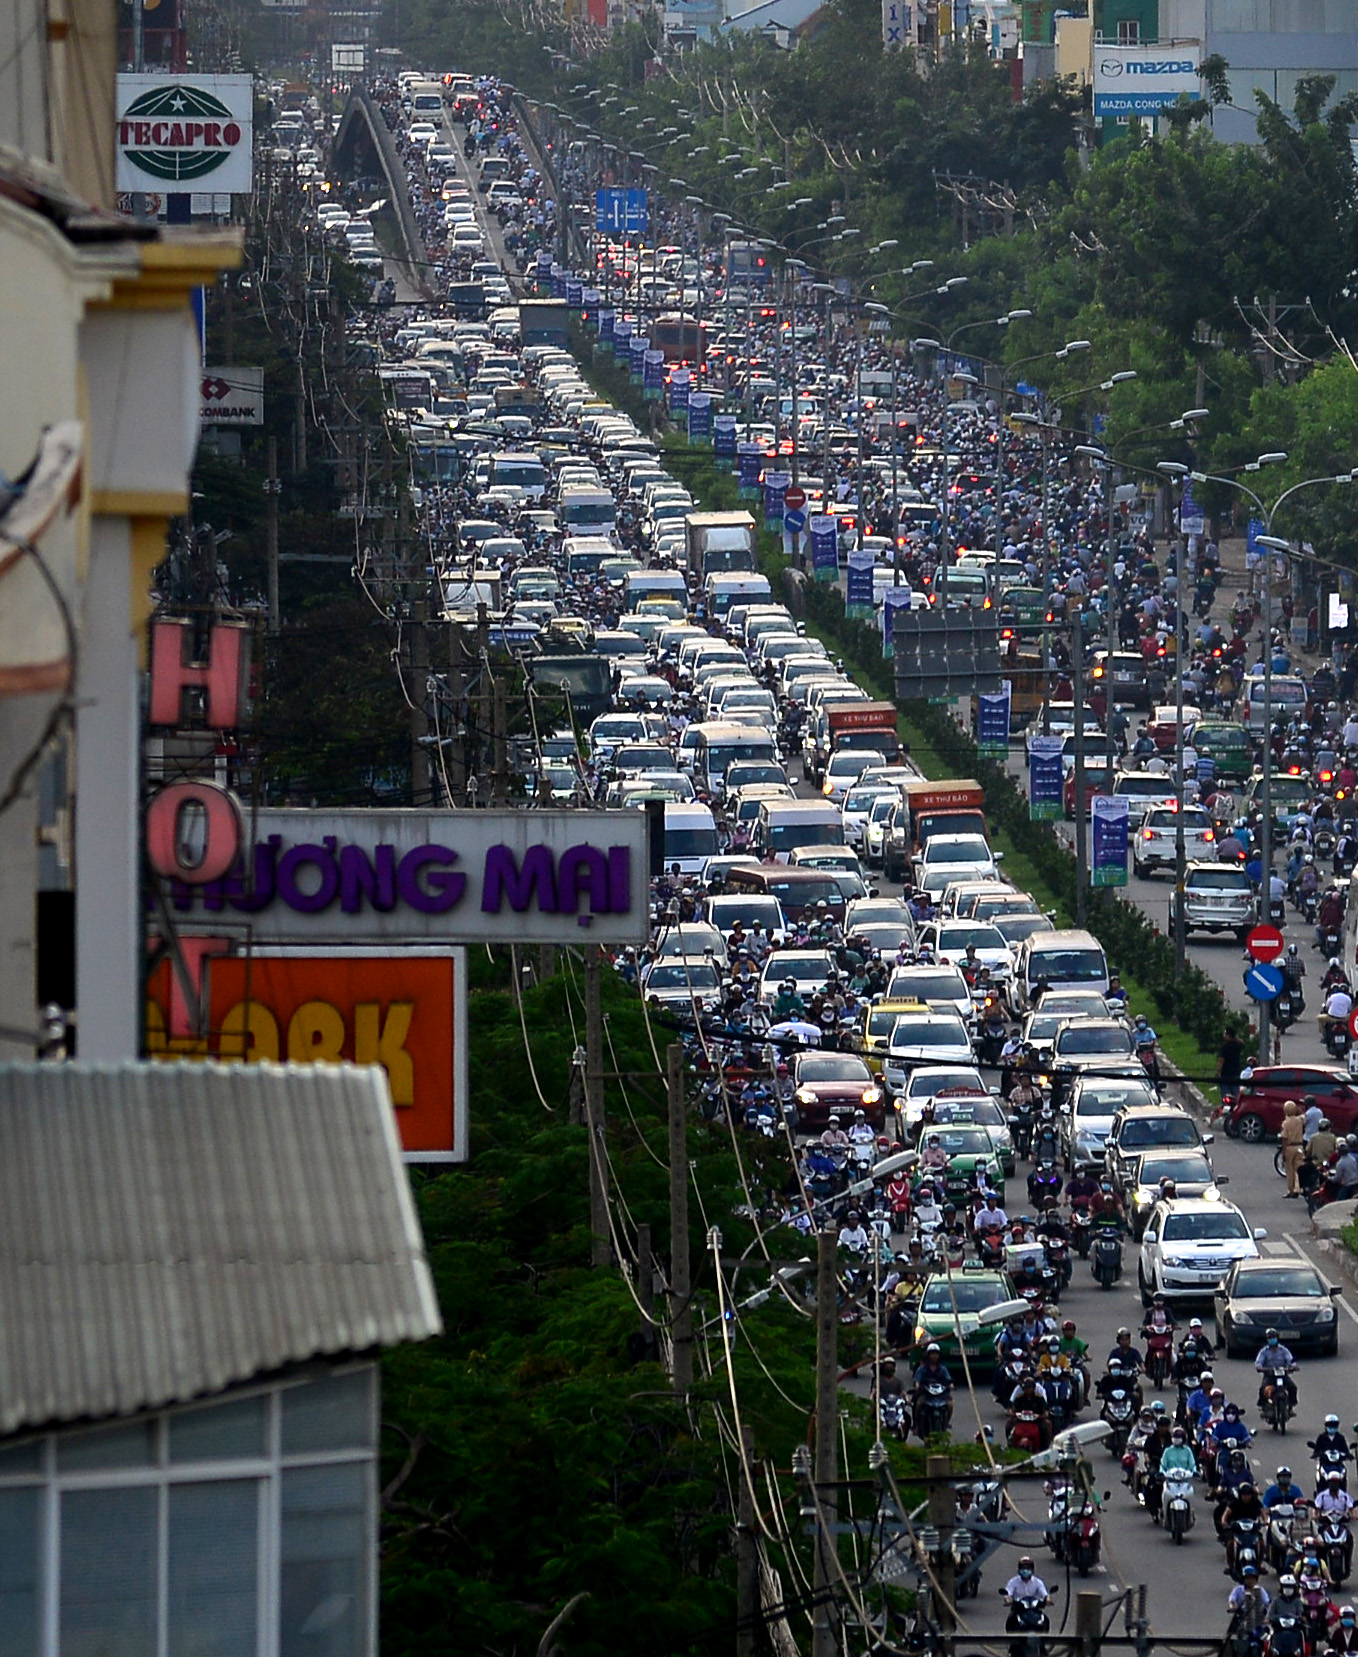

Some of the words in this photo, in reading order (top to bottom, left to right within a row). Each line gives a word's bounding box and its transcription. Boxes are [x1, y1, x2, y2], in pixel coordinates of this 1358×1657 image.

[1126, 60, 1195, 75] mazda
[1100, 100, 1133, 109] MAZDA
[116, 121, 241, 146] TECAPRO
[481, 844, 631, 928] MẠI
